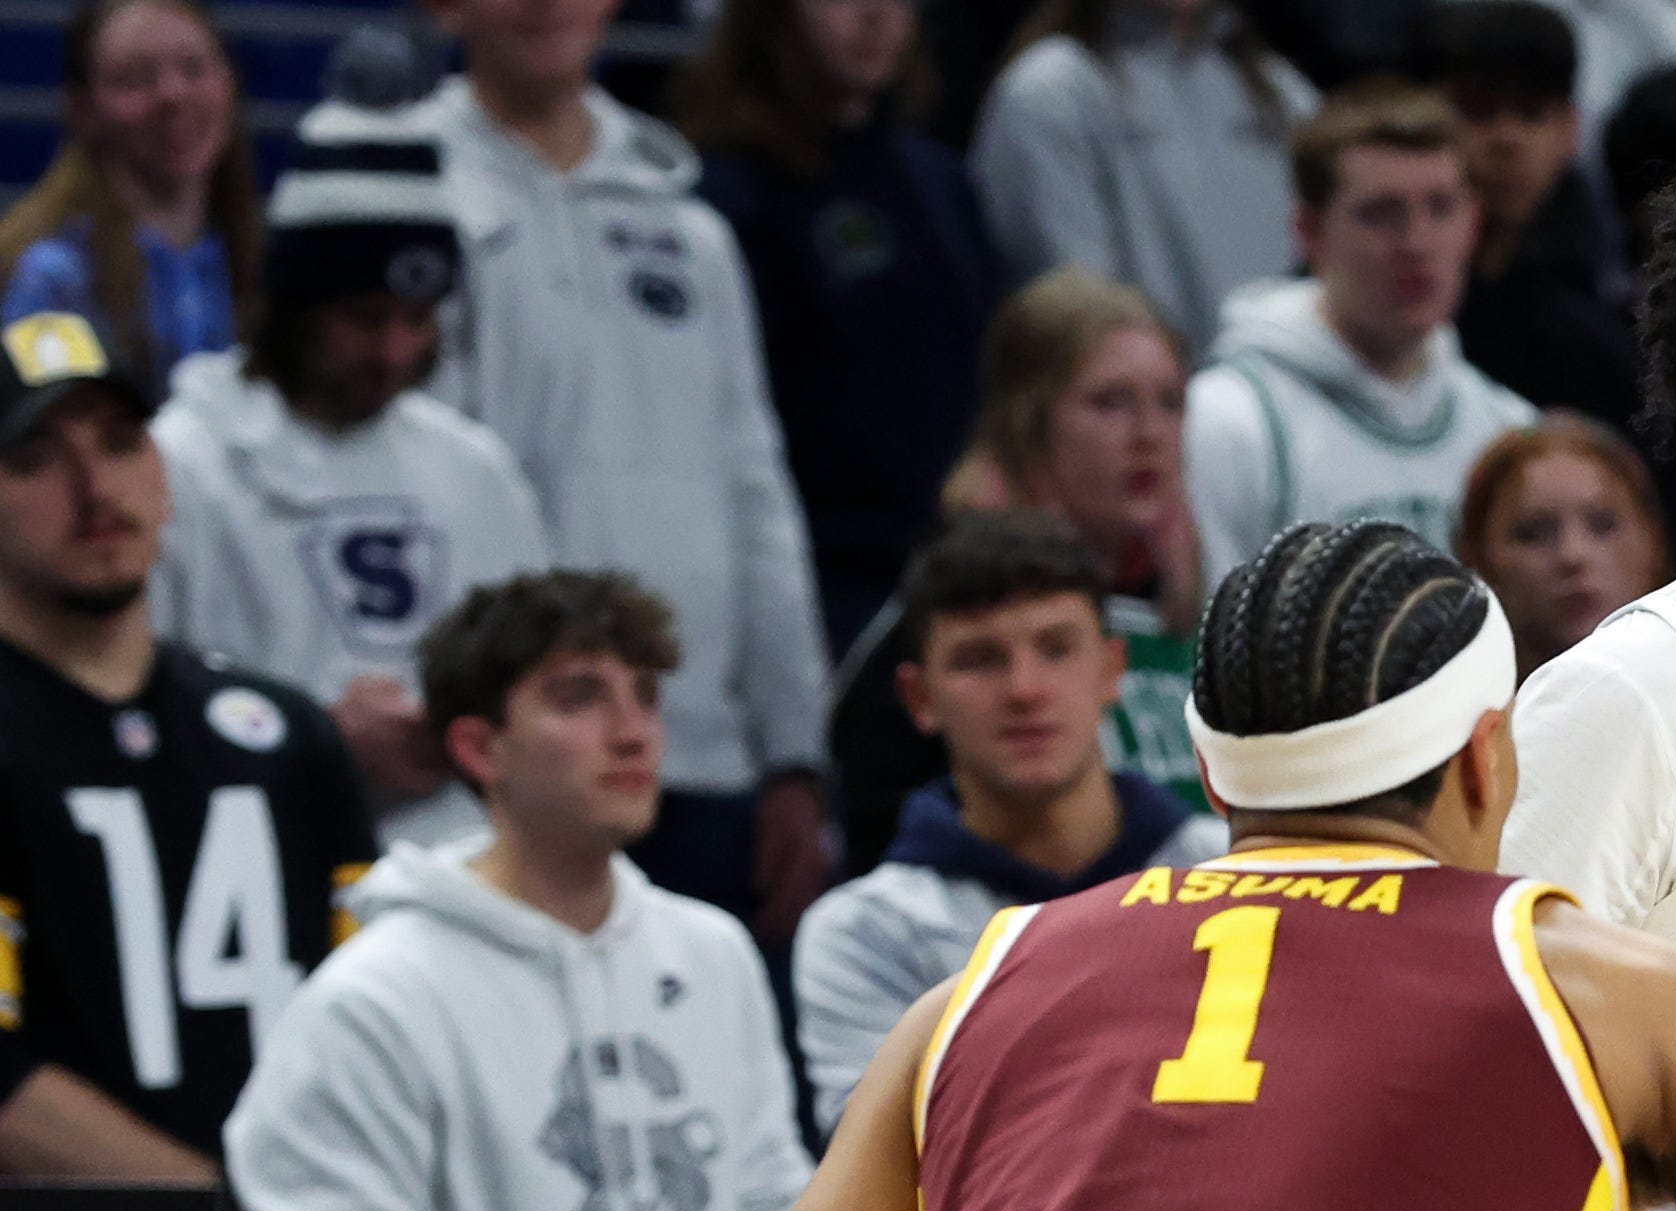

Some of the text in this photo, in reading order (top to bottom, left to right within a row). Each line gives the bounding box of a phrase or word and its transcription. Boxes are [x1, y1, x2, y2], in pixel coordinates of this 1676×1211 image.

[63, 785, 306, 1091] 14
[1119, 866, 1403, 916] ASUMA
[1152, 905, 1281, 1104] 1
